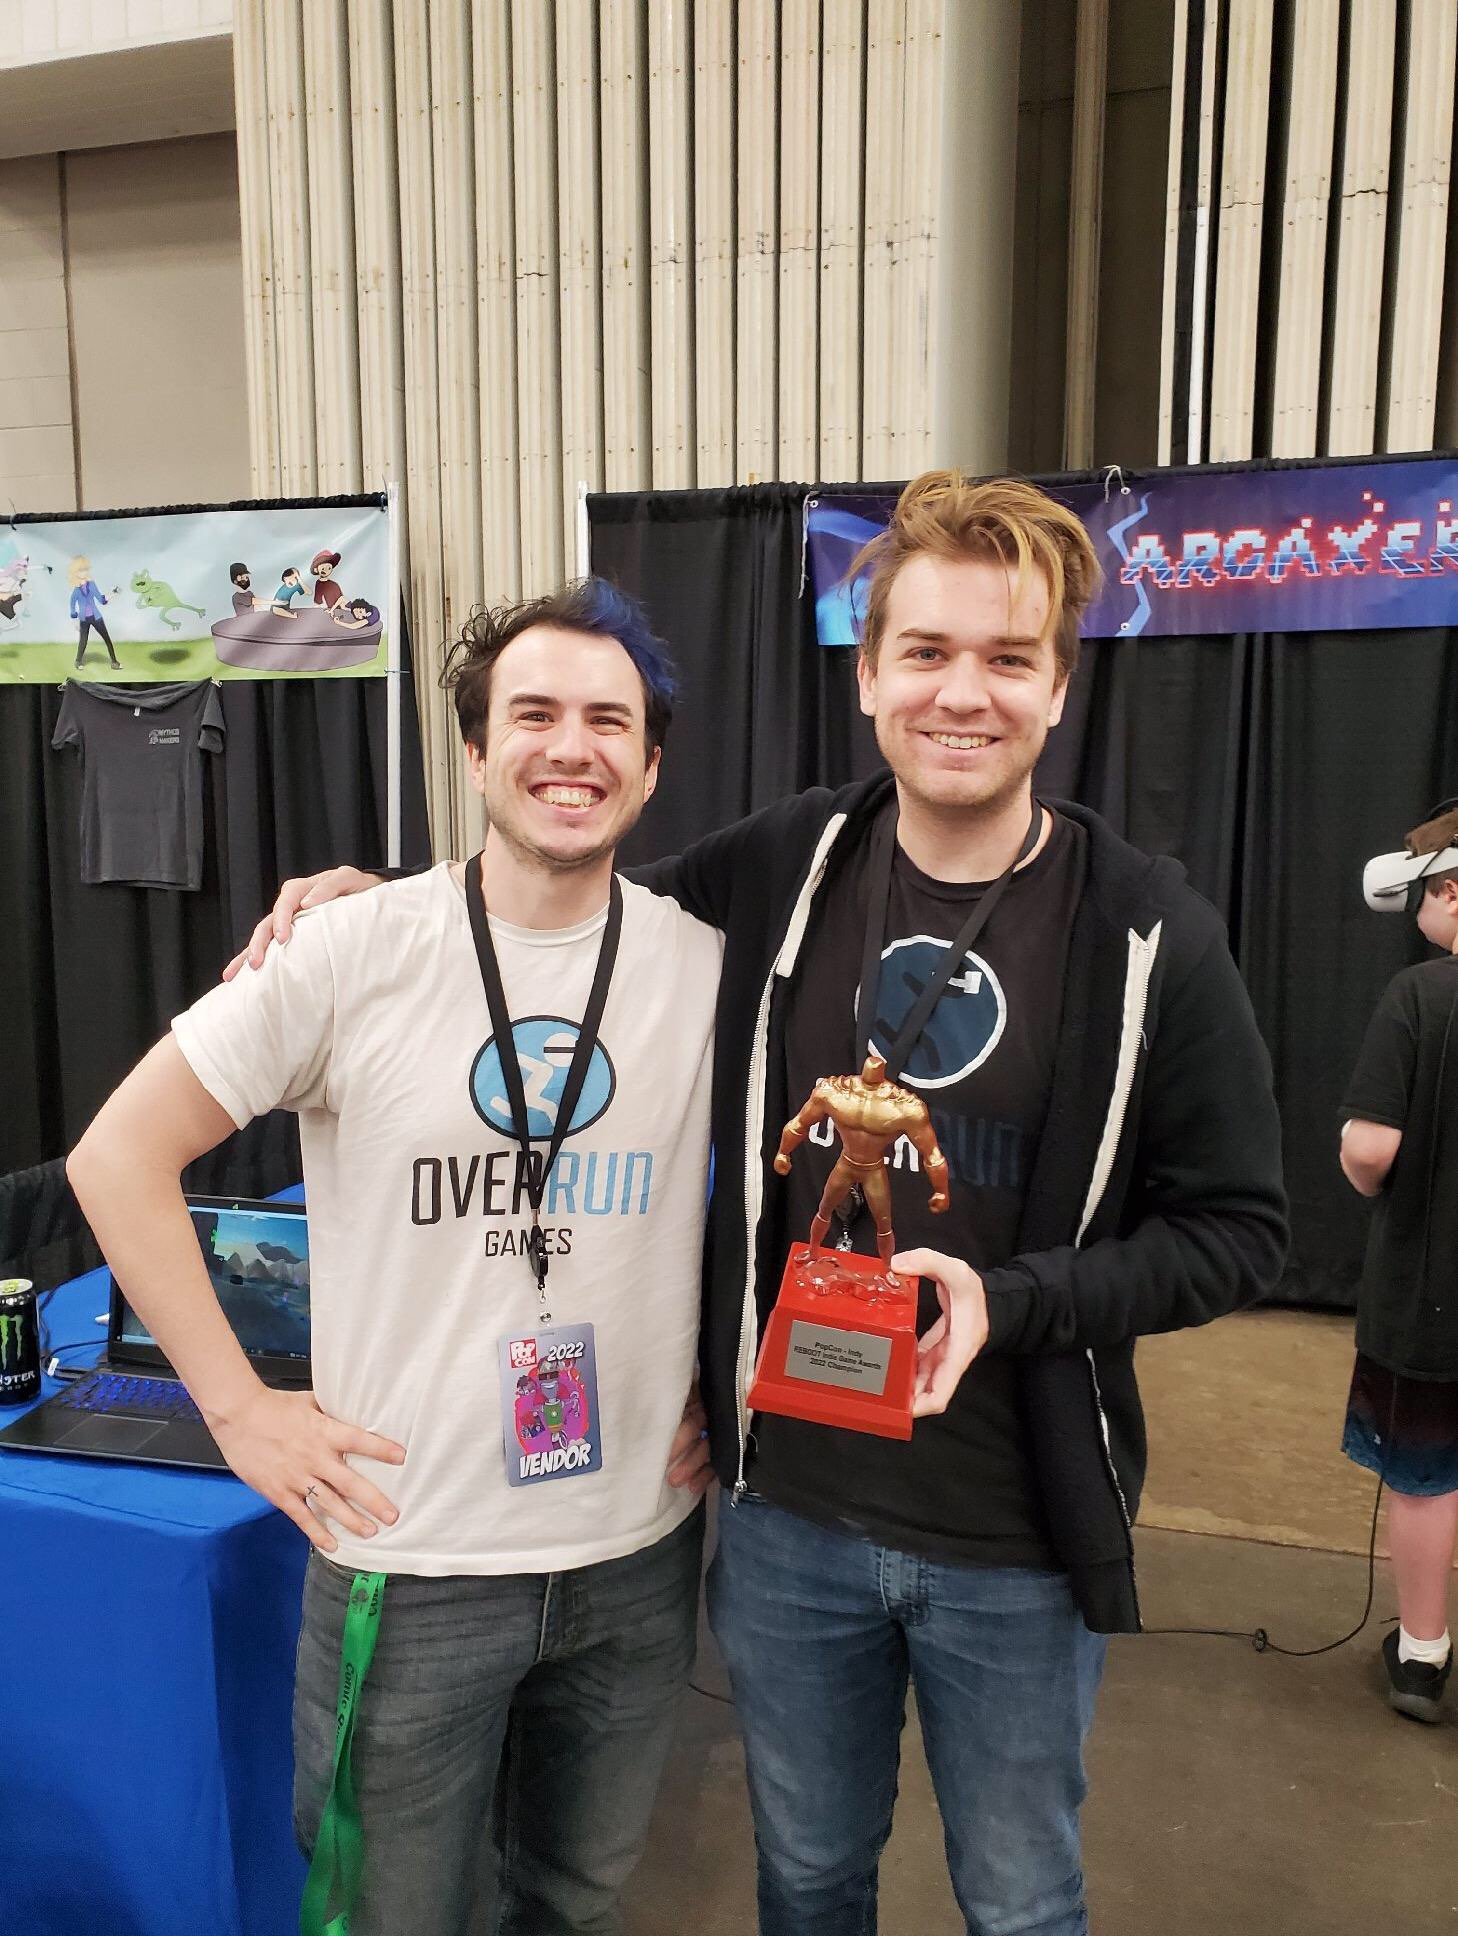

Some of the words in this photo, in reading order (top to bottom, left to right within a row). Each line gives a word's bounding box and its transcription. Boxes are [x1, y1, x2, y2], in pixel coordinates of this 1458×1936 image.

[547, 1341, 585, 1362] 2022
[793, 1345, 821, 1357] REBOOT
[839, 1355, 857, 1365] Game
[858, 1359, 882, 1370] Awards
[848, 1348, 863, 1358] Indy
[514, 1356, 536, 1367] CON
[809, 1357, 826, 1367] 2022
[827, 1361, 863, 1374] Champion
[519, 1443, 593, 1479] VENDOR
